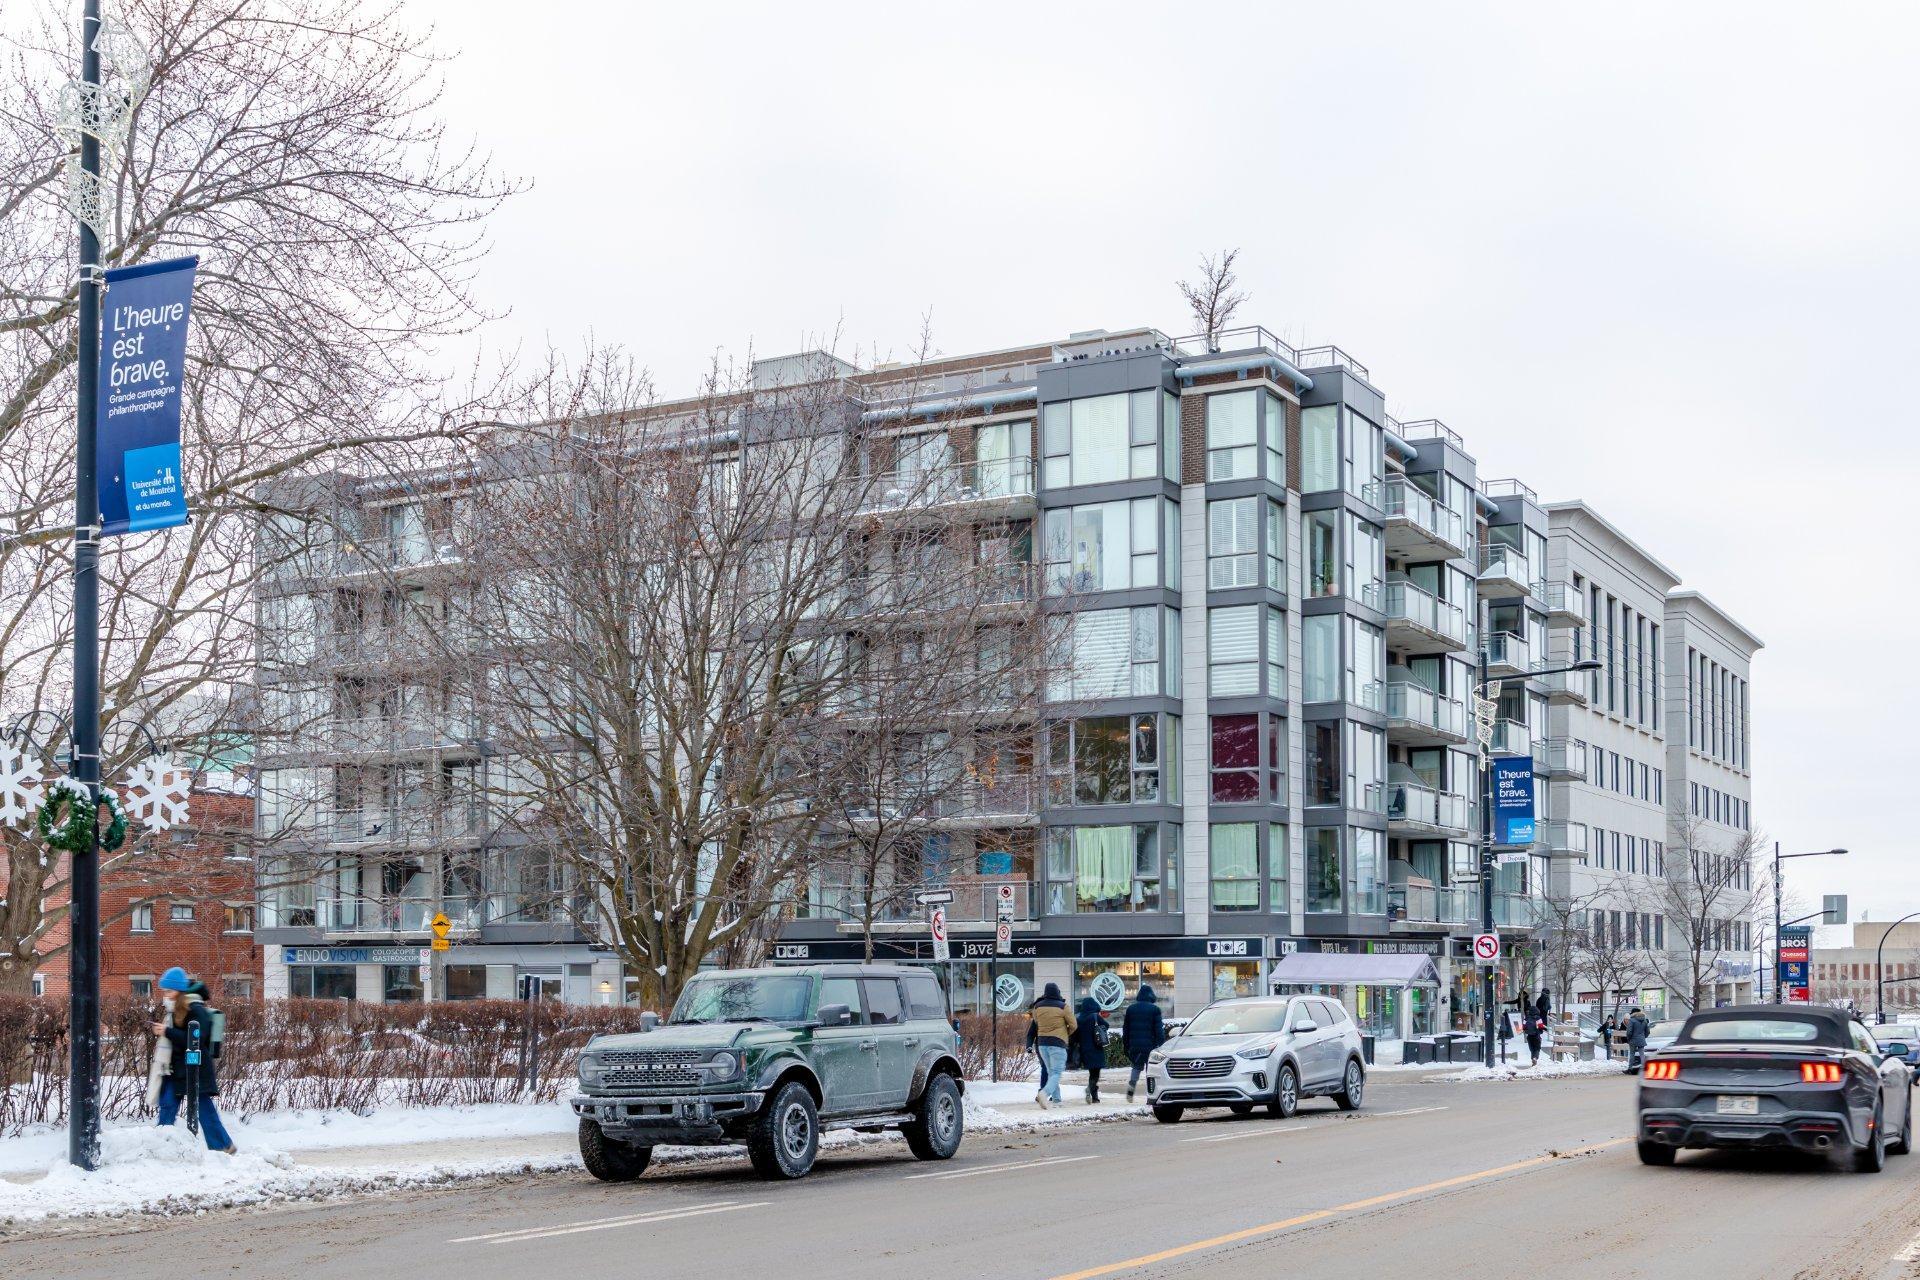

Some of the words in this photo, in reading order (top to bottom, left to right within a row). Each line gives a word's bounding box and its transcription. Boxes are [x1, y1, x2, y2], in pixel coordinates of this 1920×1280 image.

[112, 331, 144, 359] est
[110, 358, 170, 387] brave.
[109, 391, 136, 404] Grande
[136, 385, 176, 400] campagne
[108, 400, 164, 418] philanthropique
[131, 478, 162, 490] Université
[140, 488, 148, 498] de
[148, 485, 176, 496] Montréal
[135, 503, 142, 511] et
[142, 502, 150, 510] du
[1499, 780, 1514, 788] est
[1499, 788, 1528, 797] brave.
[1780, 939, 1807, 948] BROS
[1017, 946, 1037, 955] CAFÉ
